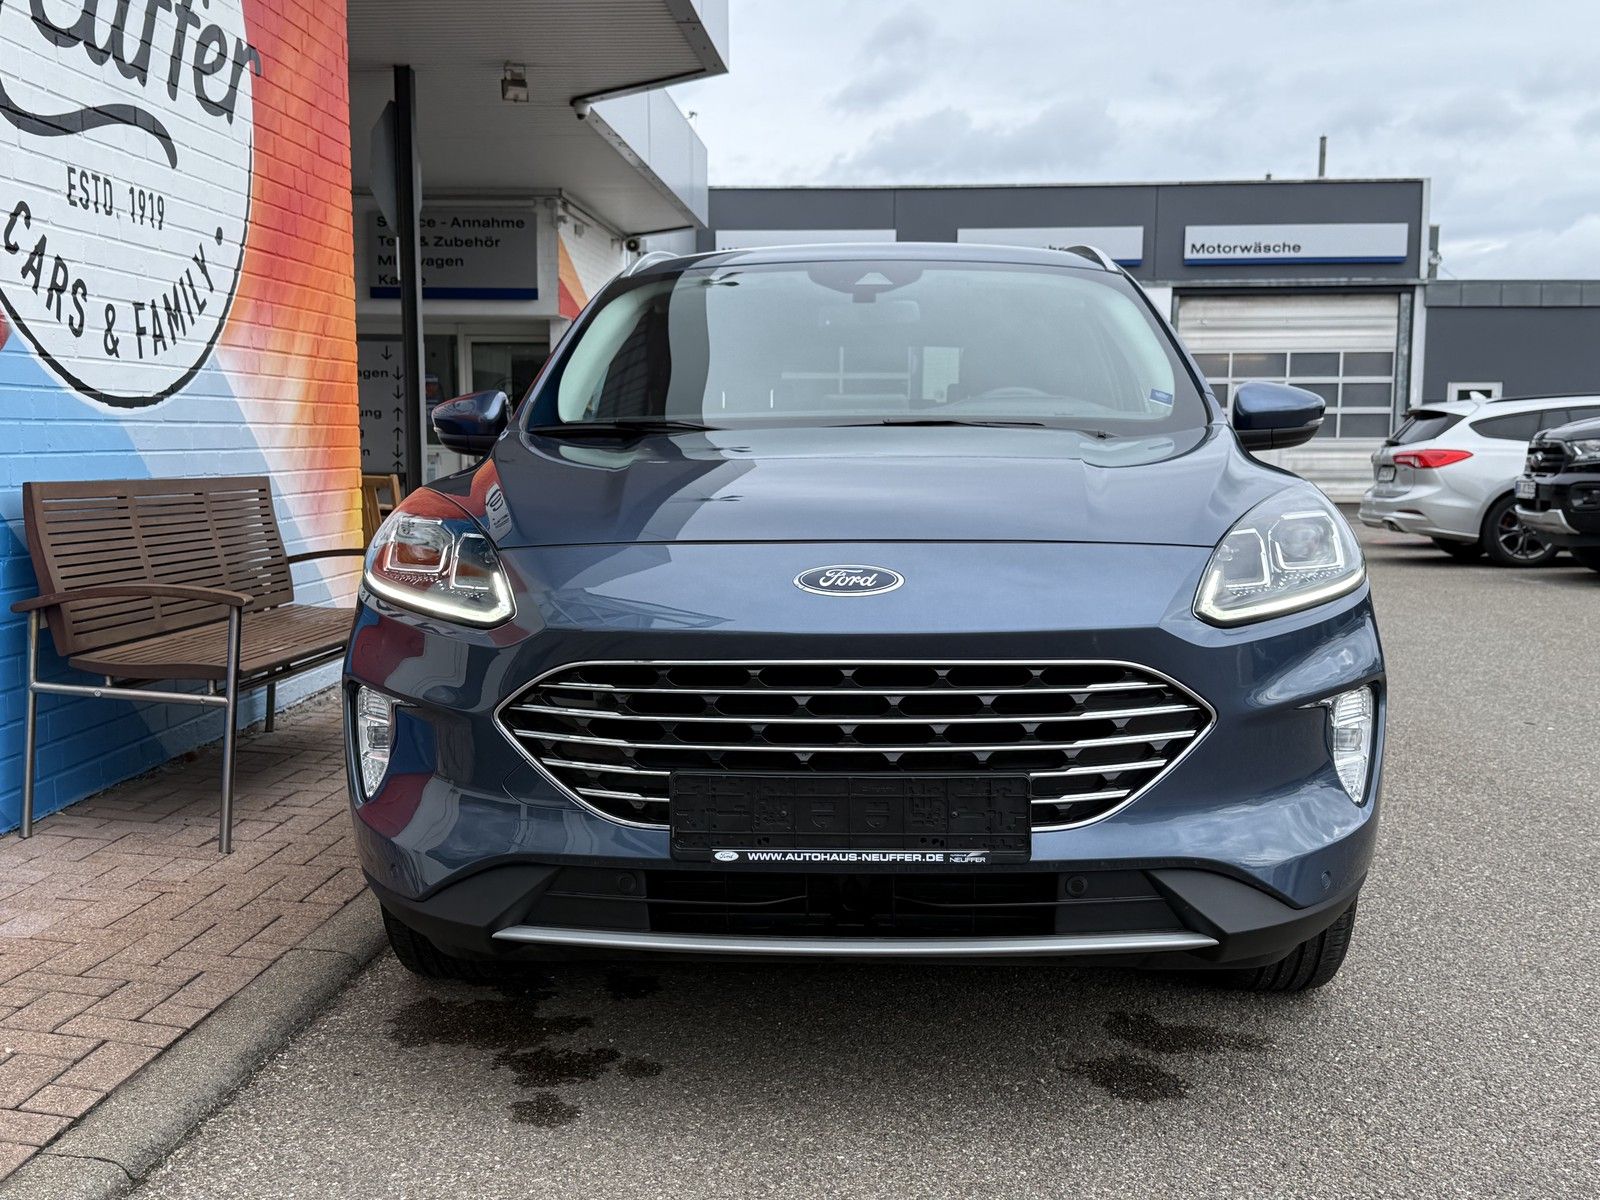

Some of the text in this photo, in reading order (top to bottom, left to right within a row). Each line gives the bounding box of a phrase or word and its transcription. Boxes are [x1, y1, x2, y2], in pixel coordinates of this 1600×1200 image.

[66, 165, 166, 231] ESTD. 1919
[450, 216, 526, 229] Annahme
[433, 235, 501, 248] Zubehör
[1189, 241, 1302, 255] Motorwäsche
[3, 200, 215, 360] CARS & FAMILY
[818, 568, 879, 588] Ford
[747, 852, 944, 862] WWW.AUTOHAUS-NEUFFER.DE
